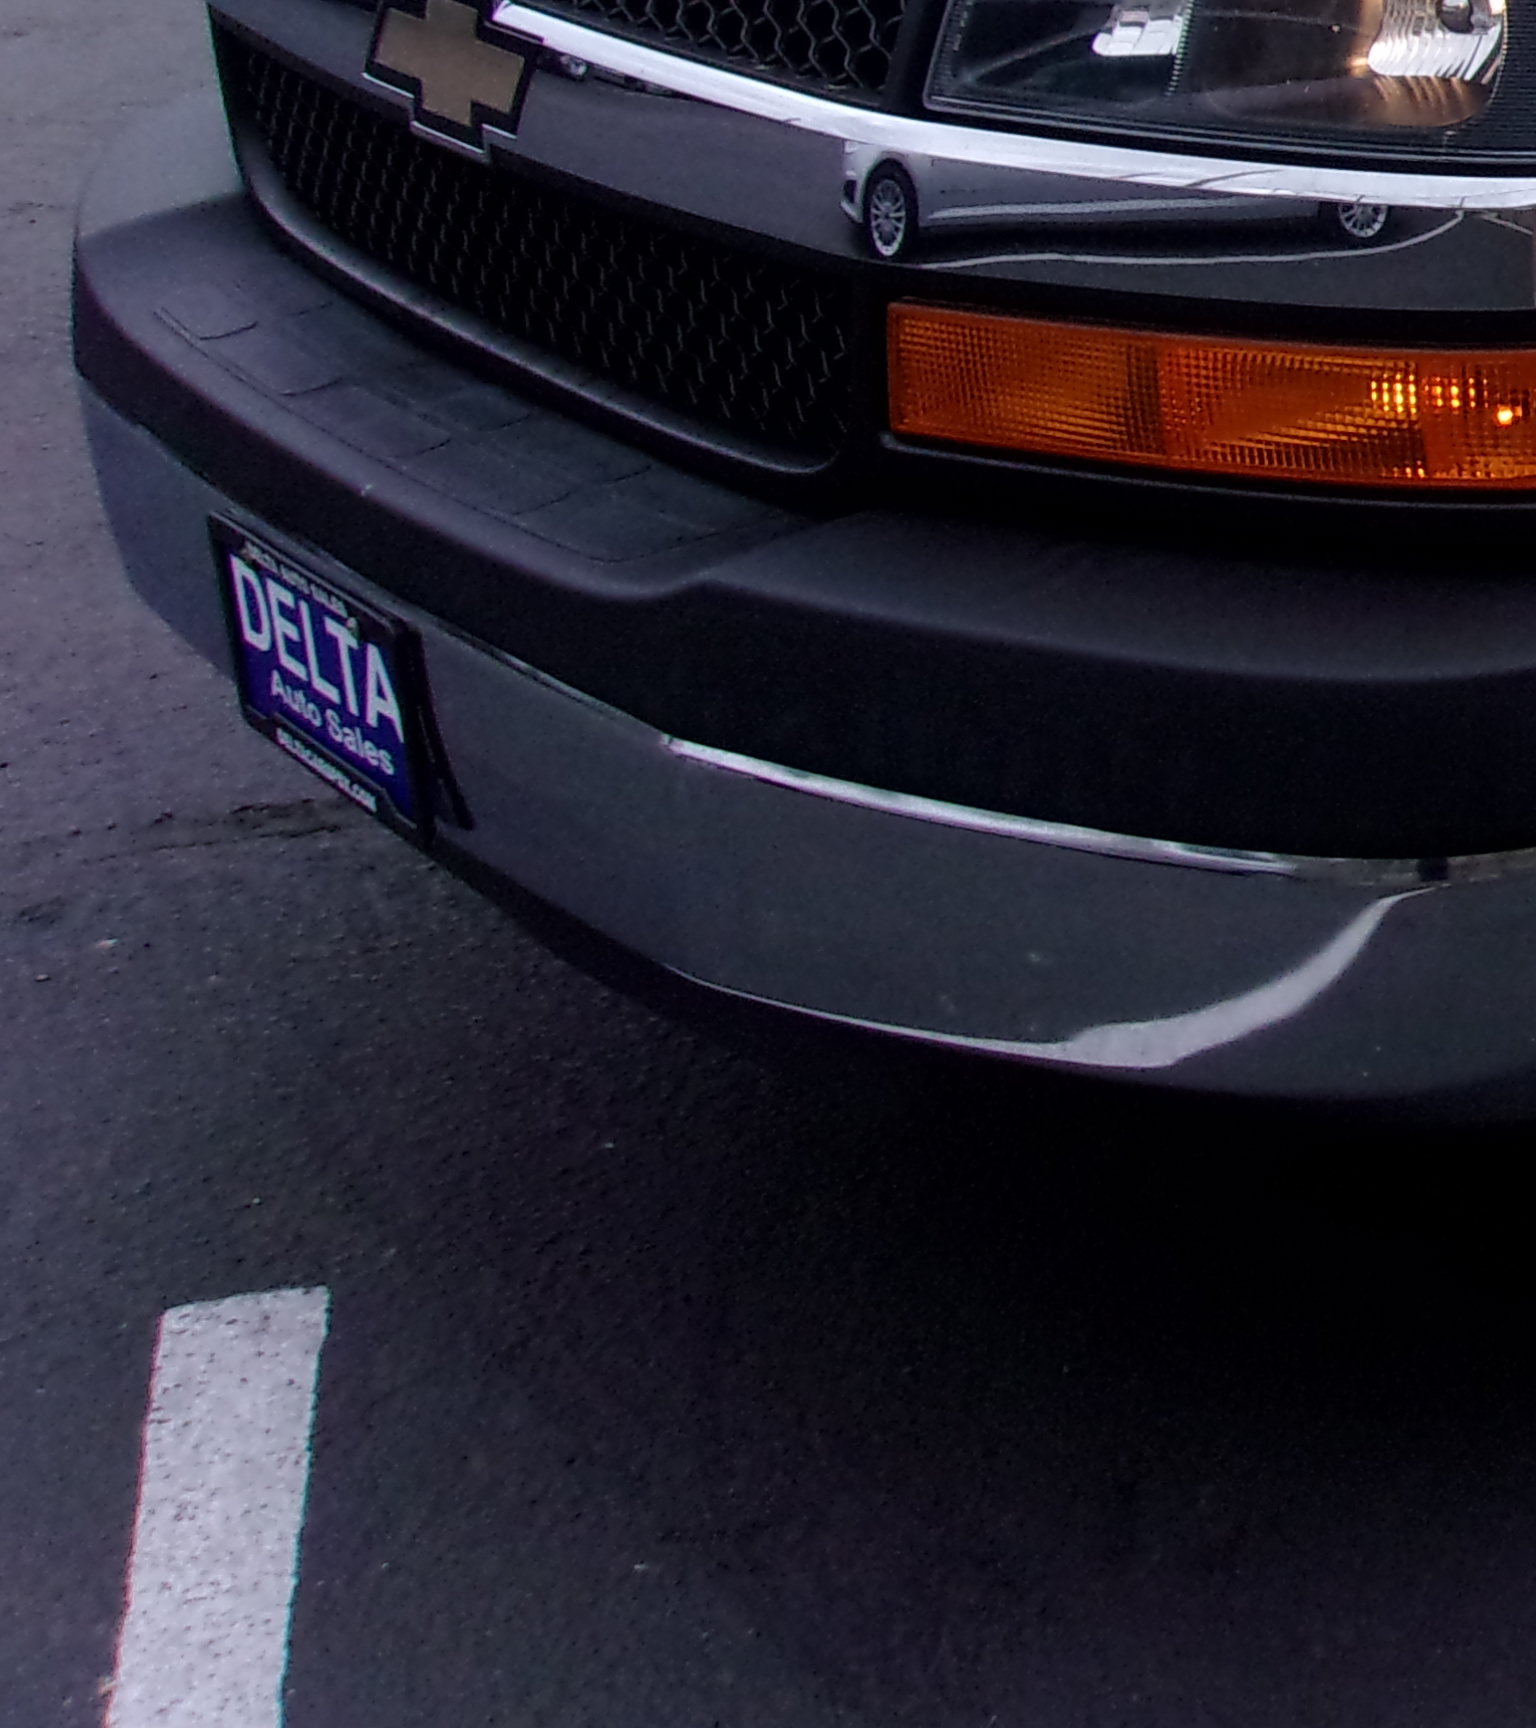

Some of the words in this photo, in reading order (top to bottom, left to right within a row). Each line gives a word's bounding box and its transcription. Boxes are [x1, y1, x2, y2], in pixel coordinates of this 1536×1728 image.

[230, 553, 404, 744] DELTA
[270, 670, 322, 728] Auto
[325, 709, 395, 775] Sales
